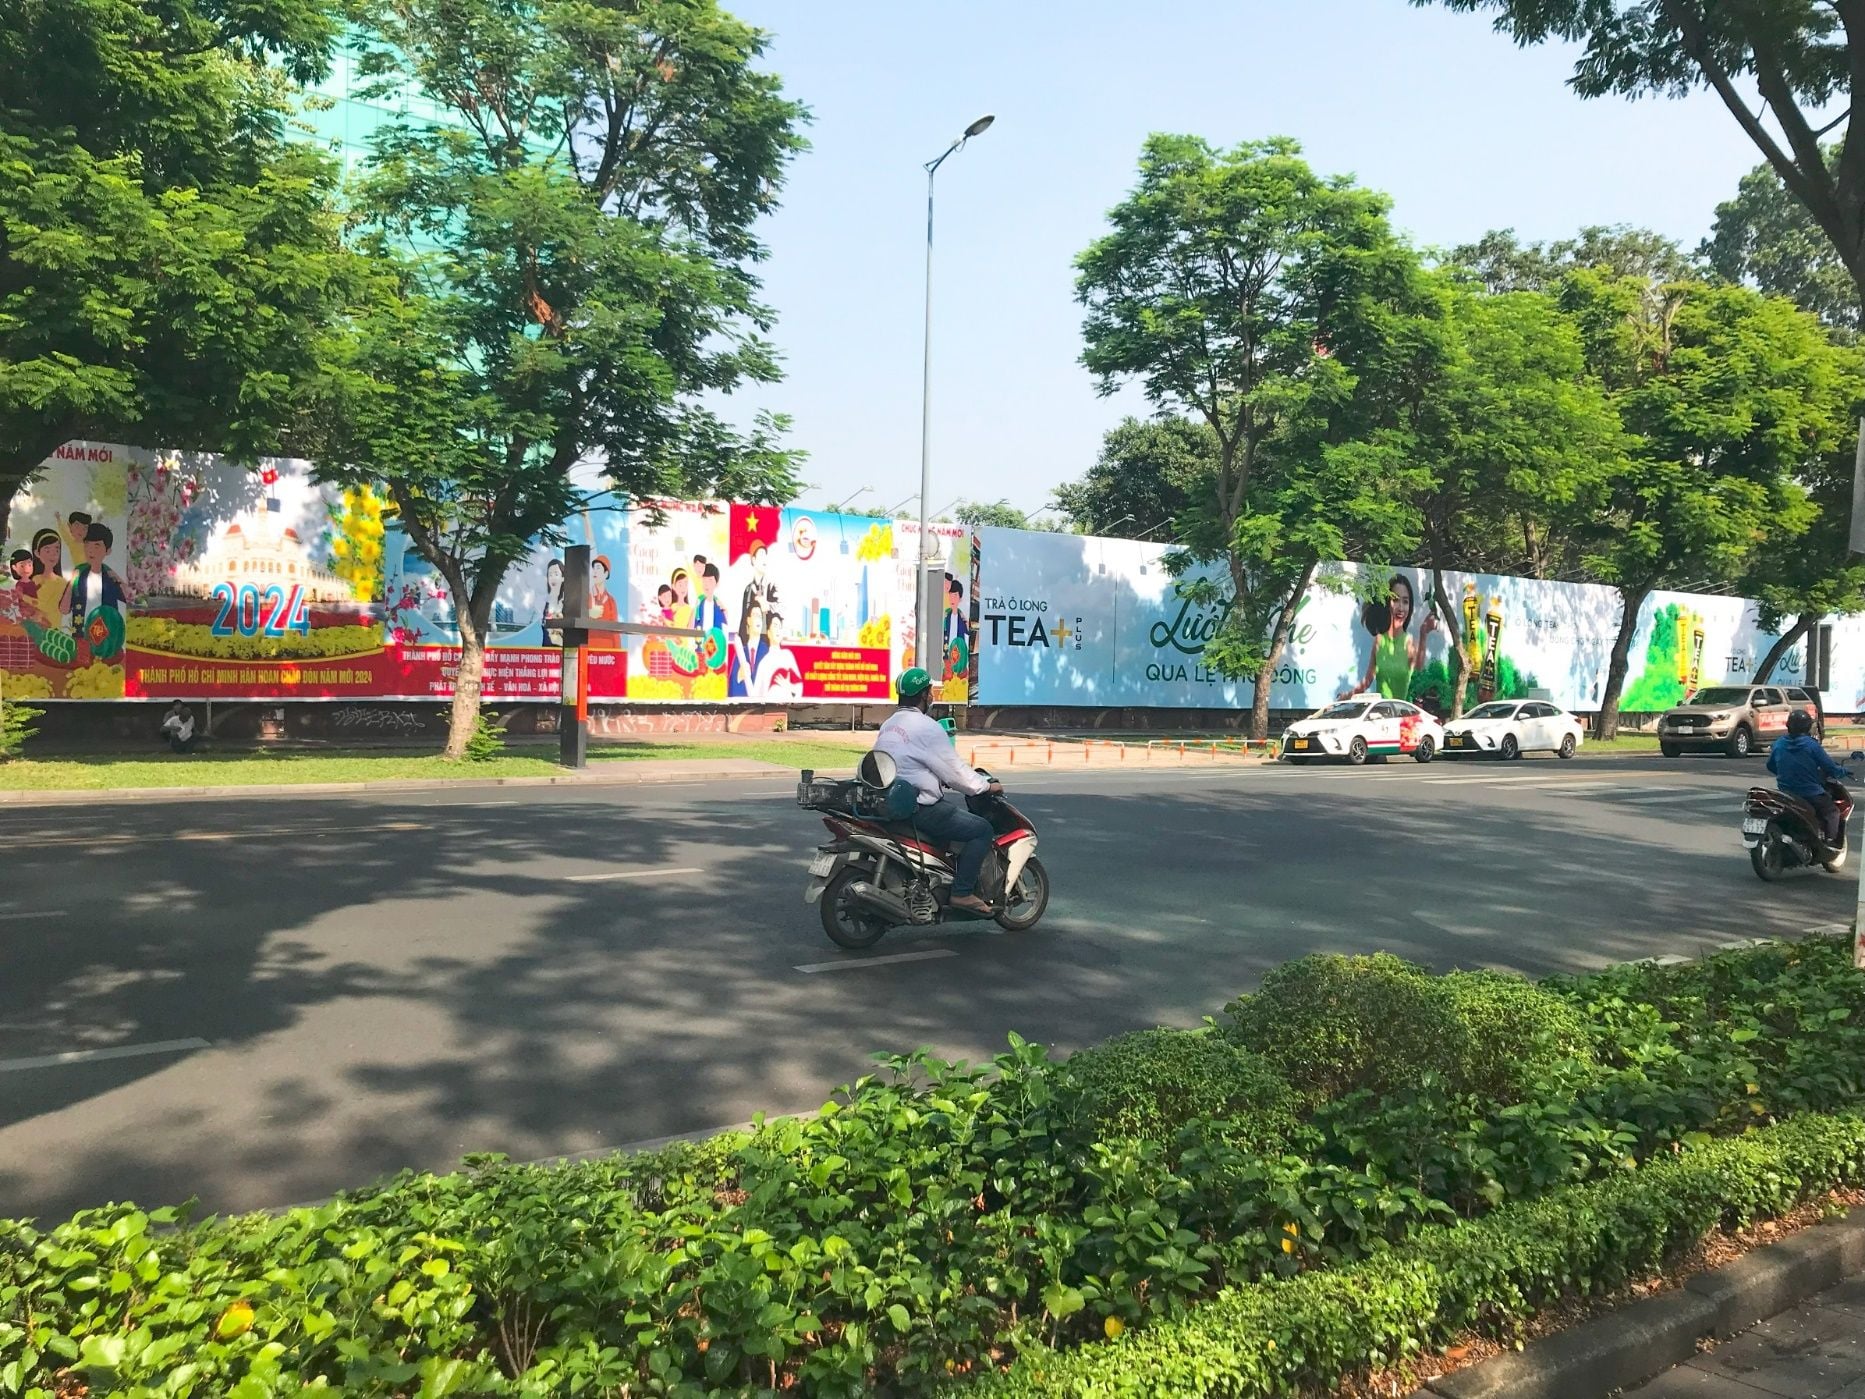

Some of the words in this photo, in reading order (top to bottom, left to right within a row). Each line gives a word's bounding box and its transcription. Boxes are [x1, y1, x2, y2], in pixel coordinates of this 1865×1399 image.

[56, 444, 85, 461] NĂM
[87, 446, 113, 463] MỚI
[211, 581, 311, 638] 2024
[985, 596, 1006, 610] TRÀ
[1008, 597, 1017, 611] Ô
[1020, 600, 1048, 612] LONG
[1075, 617, 1083, 651] PLUS
[521, 654, 543, 664] PHONG
[139, 665, 167, 684] THÀNH
[169, 664, 186, 684] PHỐ
[216, 669, 238, 684] MINH
[258, 669, 279, 684] HOAN
[355, 670, 373, 684] 2024
[1145, 663, 1188, 683] QUA
